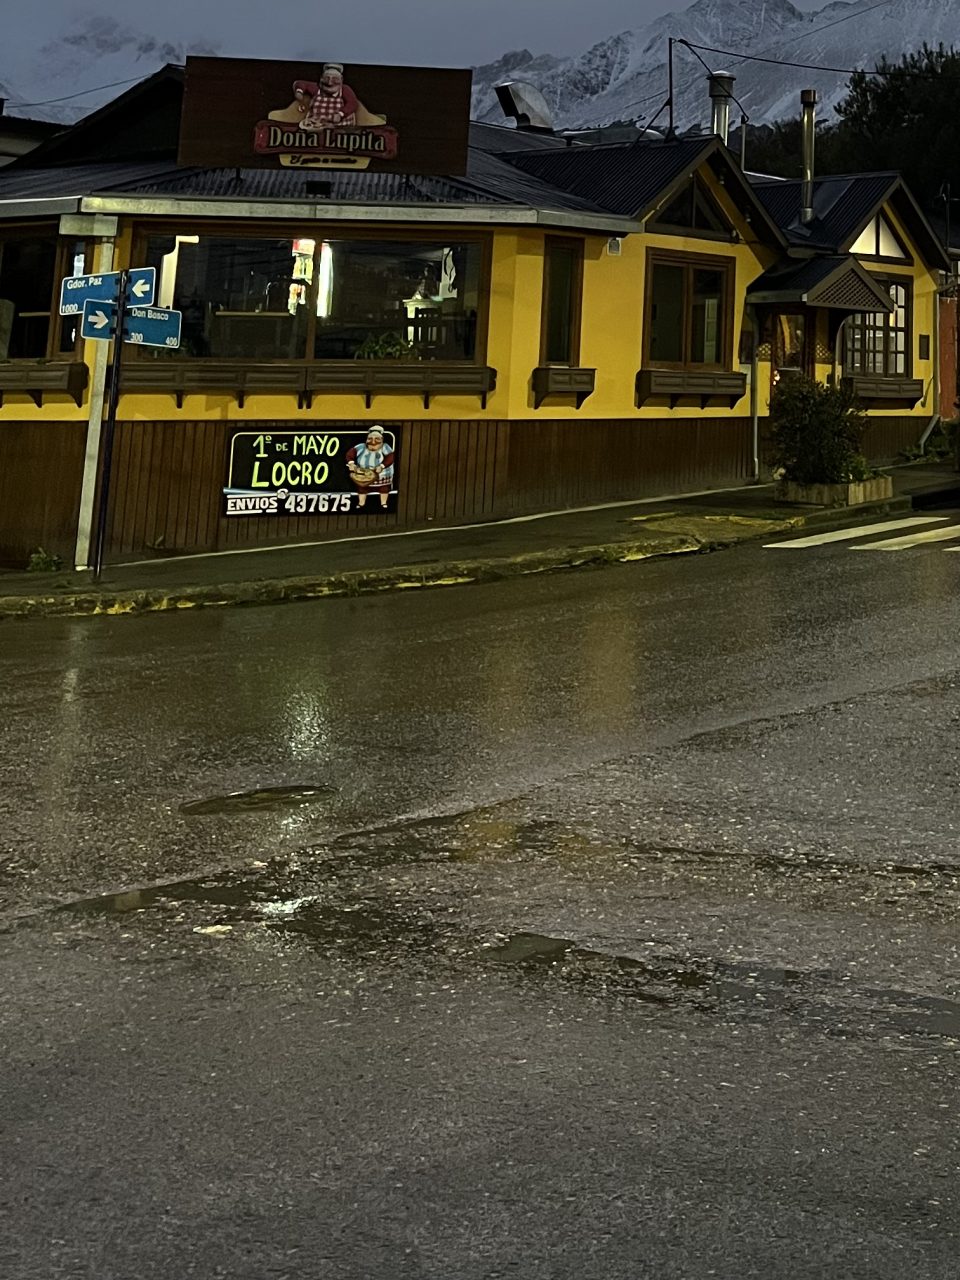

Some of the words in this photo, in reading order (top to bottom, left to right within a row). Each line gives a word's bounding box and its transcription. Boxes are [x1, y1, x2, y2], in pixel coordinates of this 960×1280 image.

[269, 126, 318, 147] Doña
[325, 129, 385, 152] Lupita
[67, 279, 88, 290] Gdor.
[88, 277, 103, 286] Paz
[62, 303, 78, 313] 1000
[131, 308, 146, 318] Don
[147, 310, 169, 321] Bosco
[130, 332, 144, 342] 300
[165, 336, 178, 346] 400
[275, 442, 289, 452] DE
[293, 435, 340, 457] MAYO
[251, 461, 329, 488] LOCRO
[227, 497, 278, 511] ENVIOS
[285, 494, 352, 513] 437675
